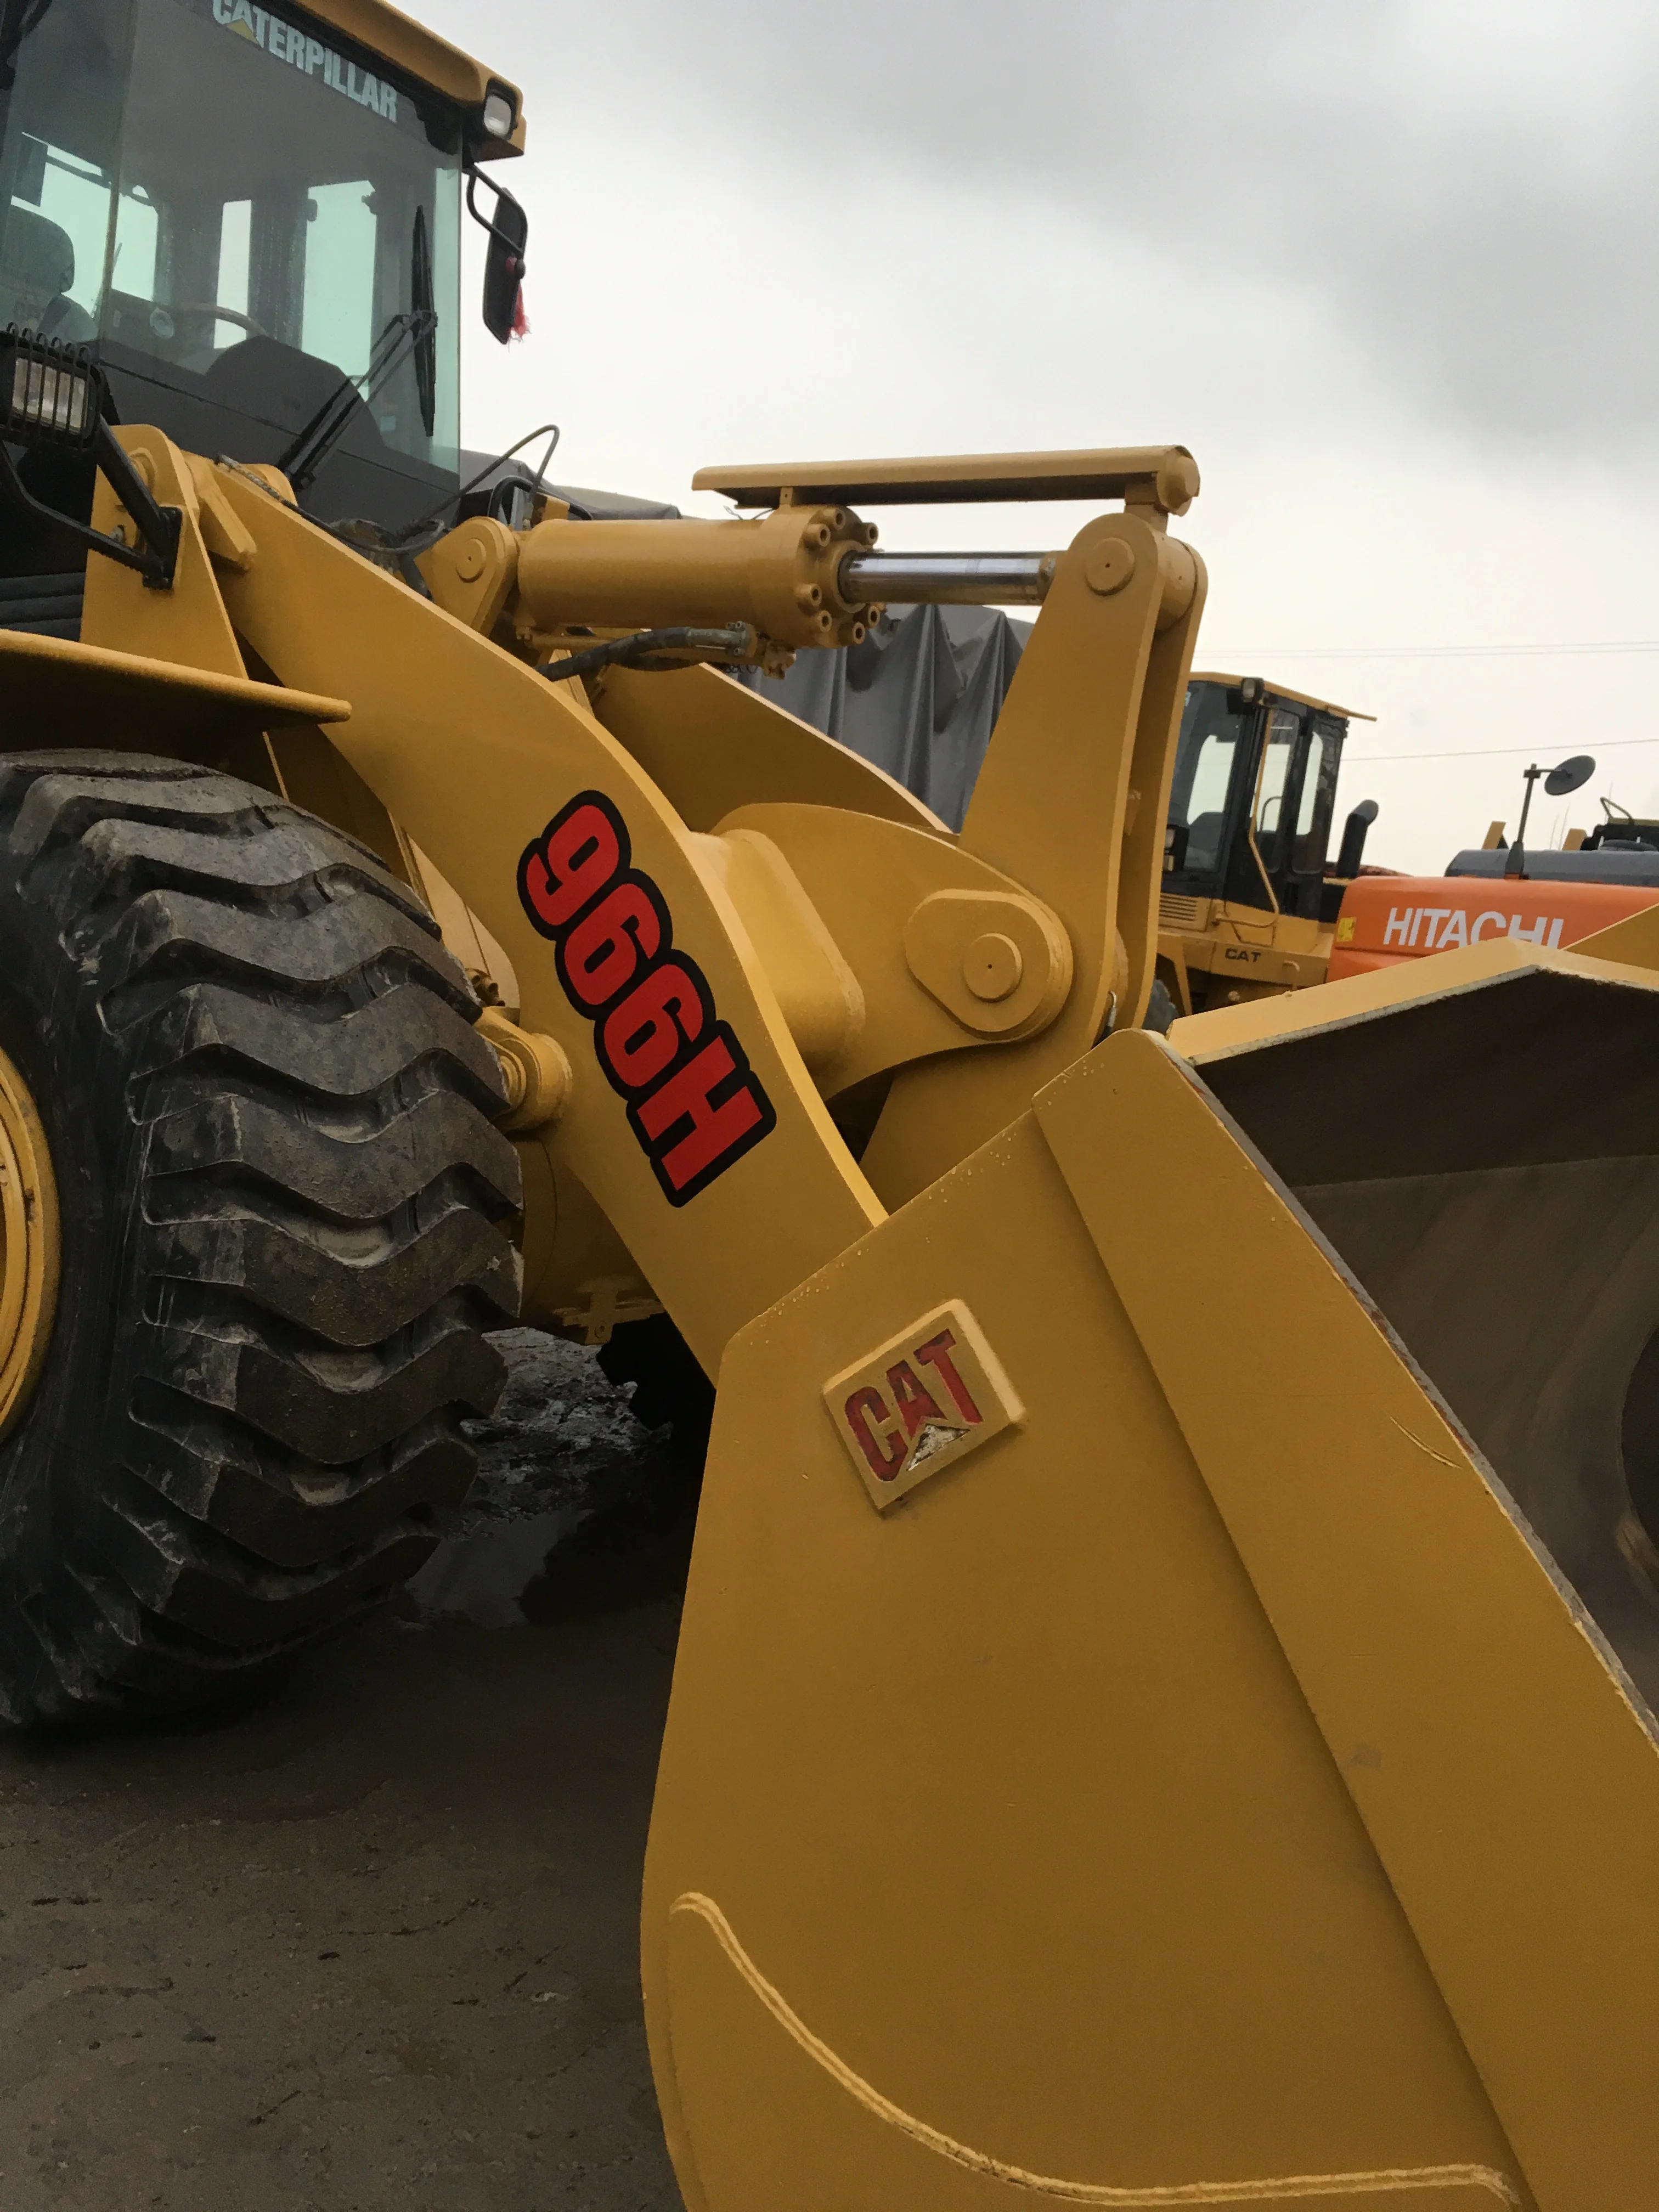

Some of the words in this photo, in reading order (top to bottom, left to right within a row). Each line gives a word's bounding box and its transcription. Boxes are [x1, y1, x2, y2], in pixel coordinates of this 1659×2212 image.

[213, 0, 397, 123] CATERPILLAR
[1225, 947, 1261, 962] CAT
[1383, 907, 1564, 950] HITACHI
[517, 789, 777, 1208] 966H
[844, 1328, 984, 1481] CAT
